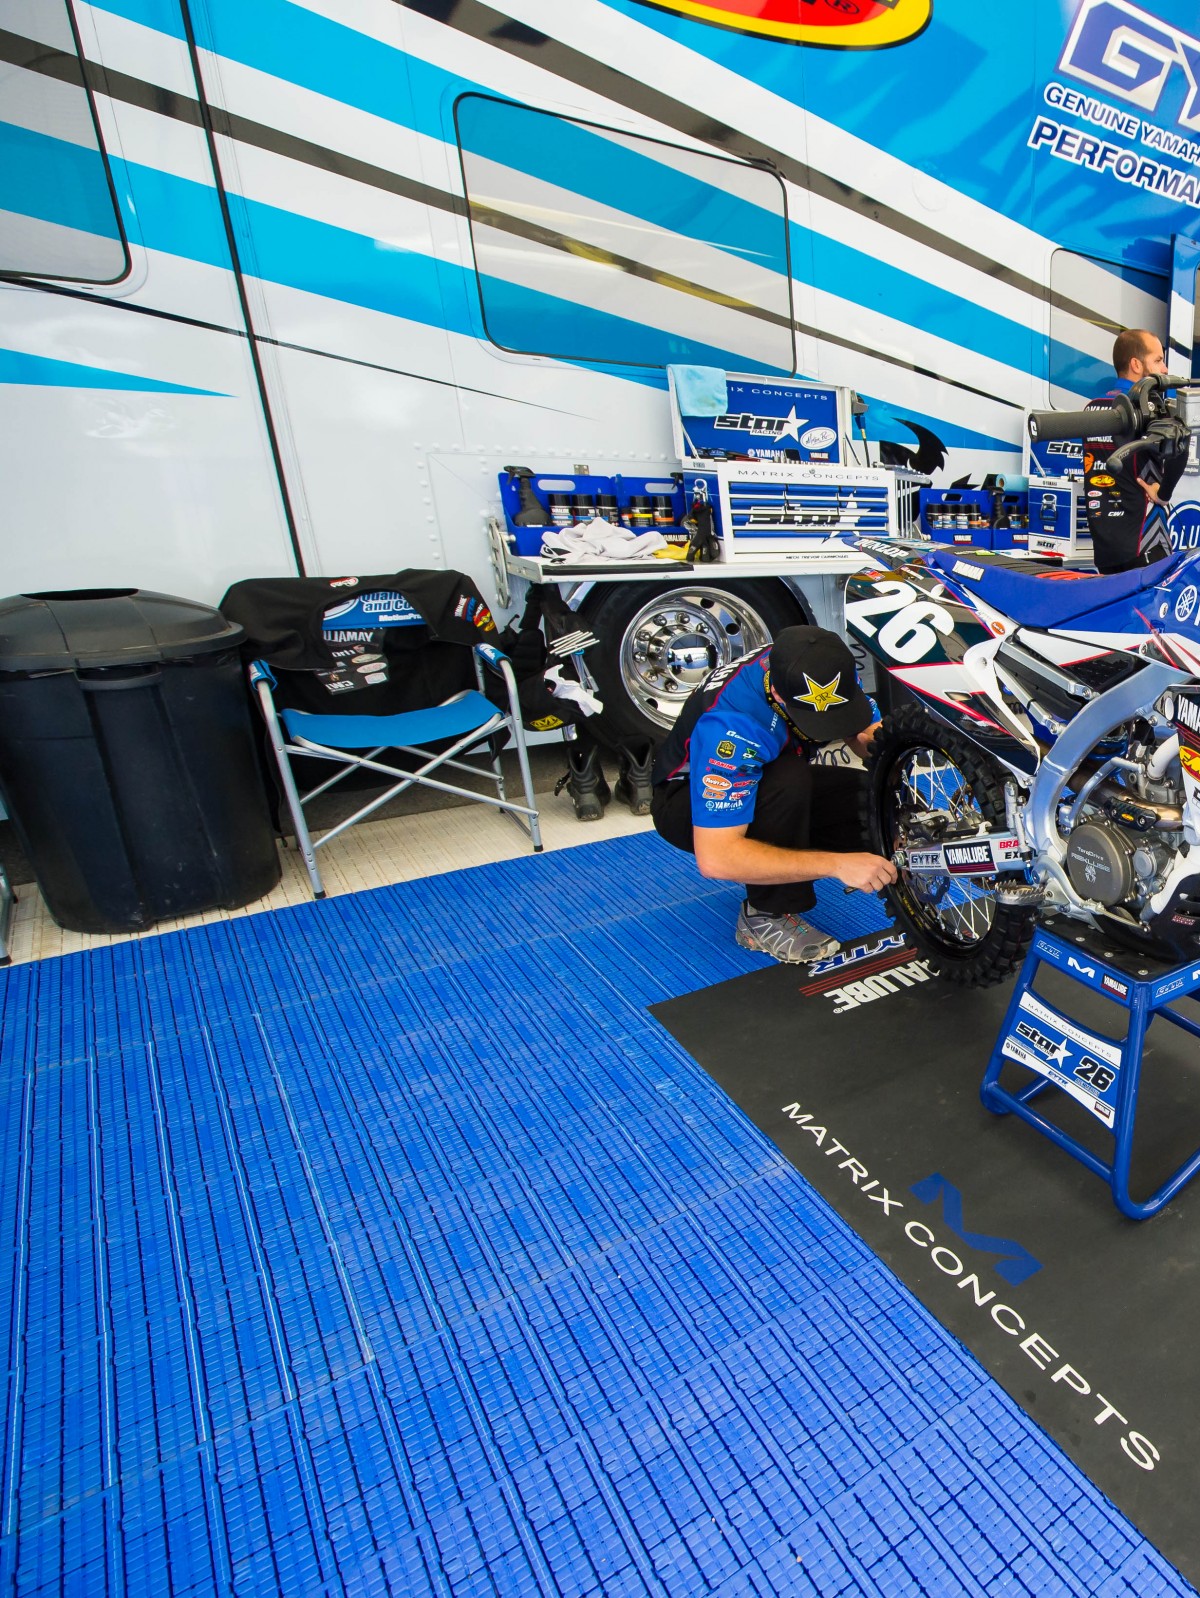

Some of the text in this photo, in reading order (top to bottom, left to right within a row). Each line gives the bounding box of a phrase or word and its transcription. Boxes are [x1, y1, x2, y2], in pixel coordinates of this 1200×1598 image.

[1044, 82, 1140, 140] GENUINE
[751, 388, 828, 401] CONCEPTS
[755, 448, 785, 458] YAMAHA
[737, 470, 880, 481] MATRIX CONCEPTS
[854, 539, 910, 558] DUNLOP
[363, 599, 393, 613] and
[845, 580, 955, 664] 26
[715, 799, 744, 810] YAMAHA
[911, 852, 941, 865] GYTR
[946, 846, 990, 864] YAMALUBE
[1005, 850, 1039, 860] EXL
[807, 932, 907, 975] YTR
[823, 958, 941, 1012] ALUBE
[1103, 974, 1128, 996] YAMALUBE
[1017, 1022, 1061, 1056] star
[1028, 1003, 1059, 1025] MATRIX
[1061, 1024, 1112, 1058] CONCEPTS
[1010, 1045, 1027, 1060] YAMAHA
[1073, 1055, 1116, 1093] 26
[781, 1102, 1161, 1472] MATRIX CONCEPTS
